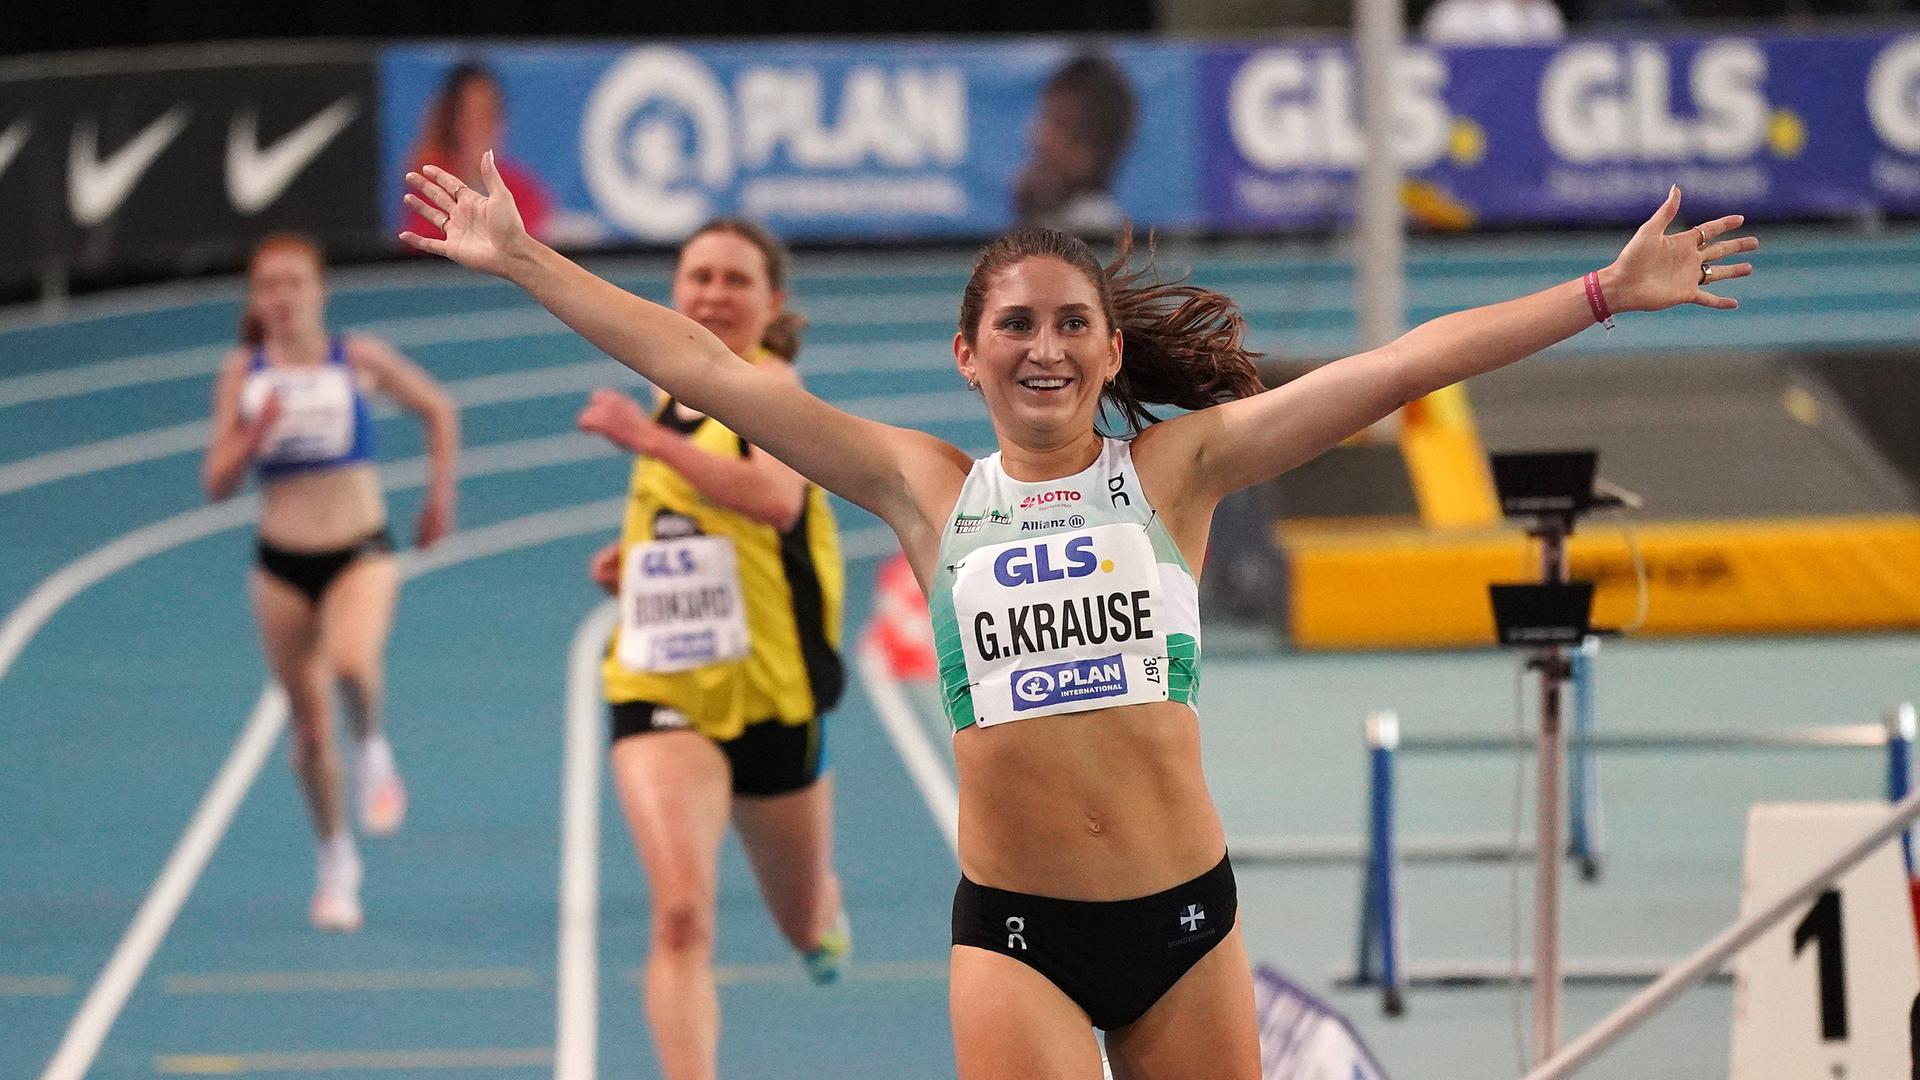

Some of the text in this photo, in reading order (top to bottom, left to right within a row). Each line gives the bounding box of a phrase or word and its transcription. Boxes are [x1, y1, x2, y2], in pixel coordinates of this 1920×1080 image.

[1037, 490, 1081, 505] LOTTO
[1021, 519, 1066, 531] Allianz
[974, 590, 1154, 661] G.KRAUSE
[1059, 663, 1121, 687] PLAN
[1143, 657, 1161, 684] 367
[1061, 684, 1123, 697] INTERNATIONAL
[1793, 889, 1849, 1040] 1
